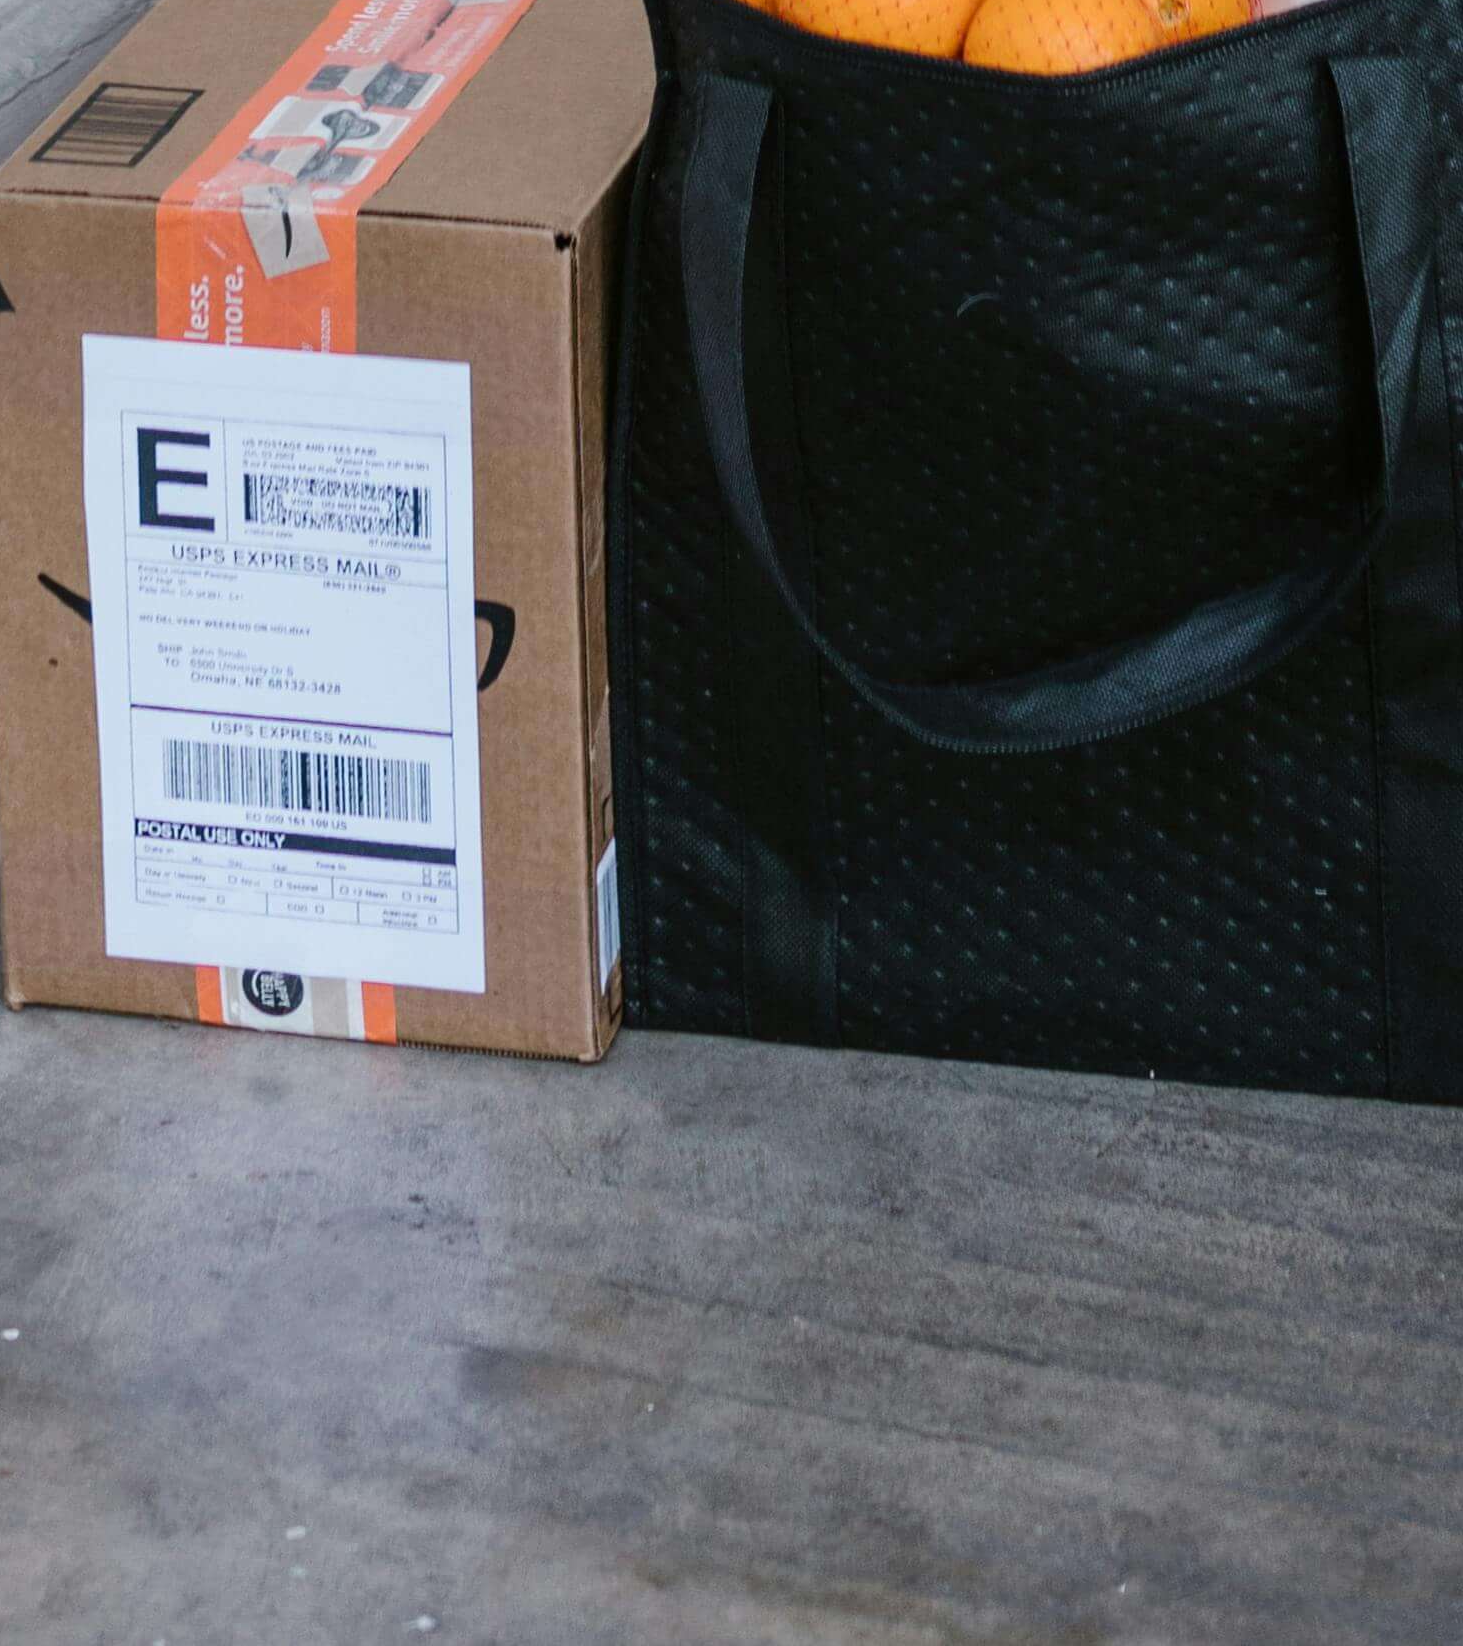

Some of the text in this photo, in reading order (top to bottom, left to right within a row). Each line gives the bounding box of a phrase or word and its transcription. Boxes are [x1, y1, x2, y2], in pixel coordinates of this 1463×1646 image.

[183, 274, 210, 341] less.
[137, 427, 215, 534] E
[171, 544, 226, 564] USPS
[234, 549, 330, 574] EXPRESS
[164, 657, 180, 668] TO
[245, 675, 263, 688] NE
[211, 720, 378, 750] USPS EXPRESS MAIL
[137, 820, 287, 849] POSTAL USE ONLY
